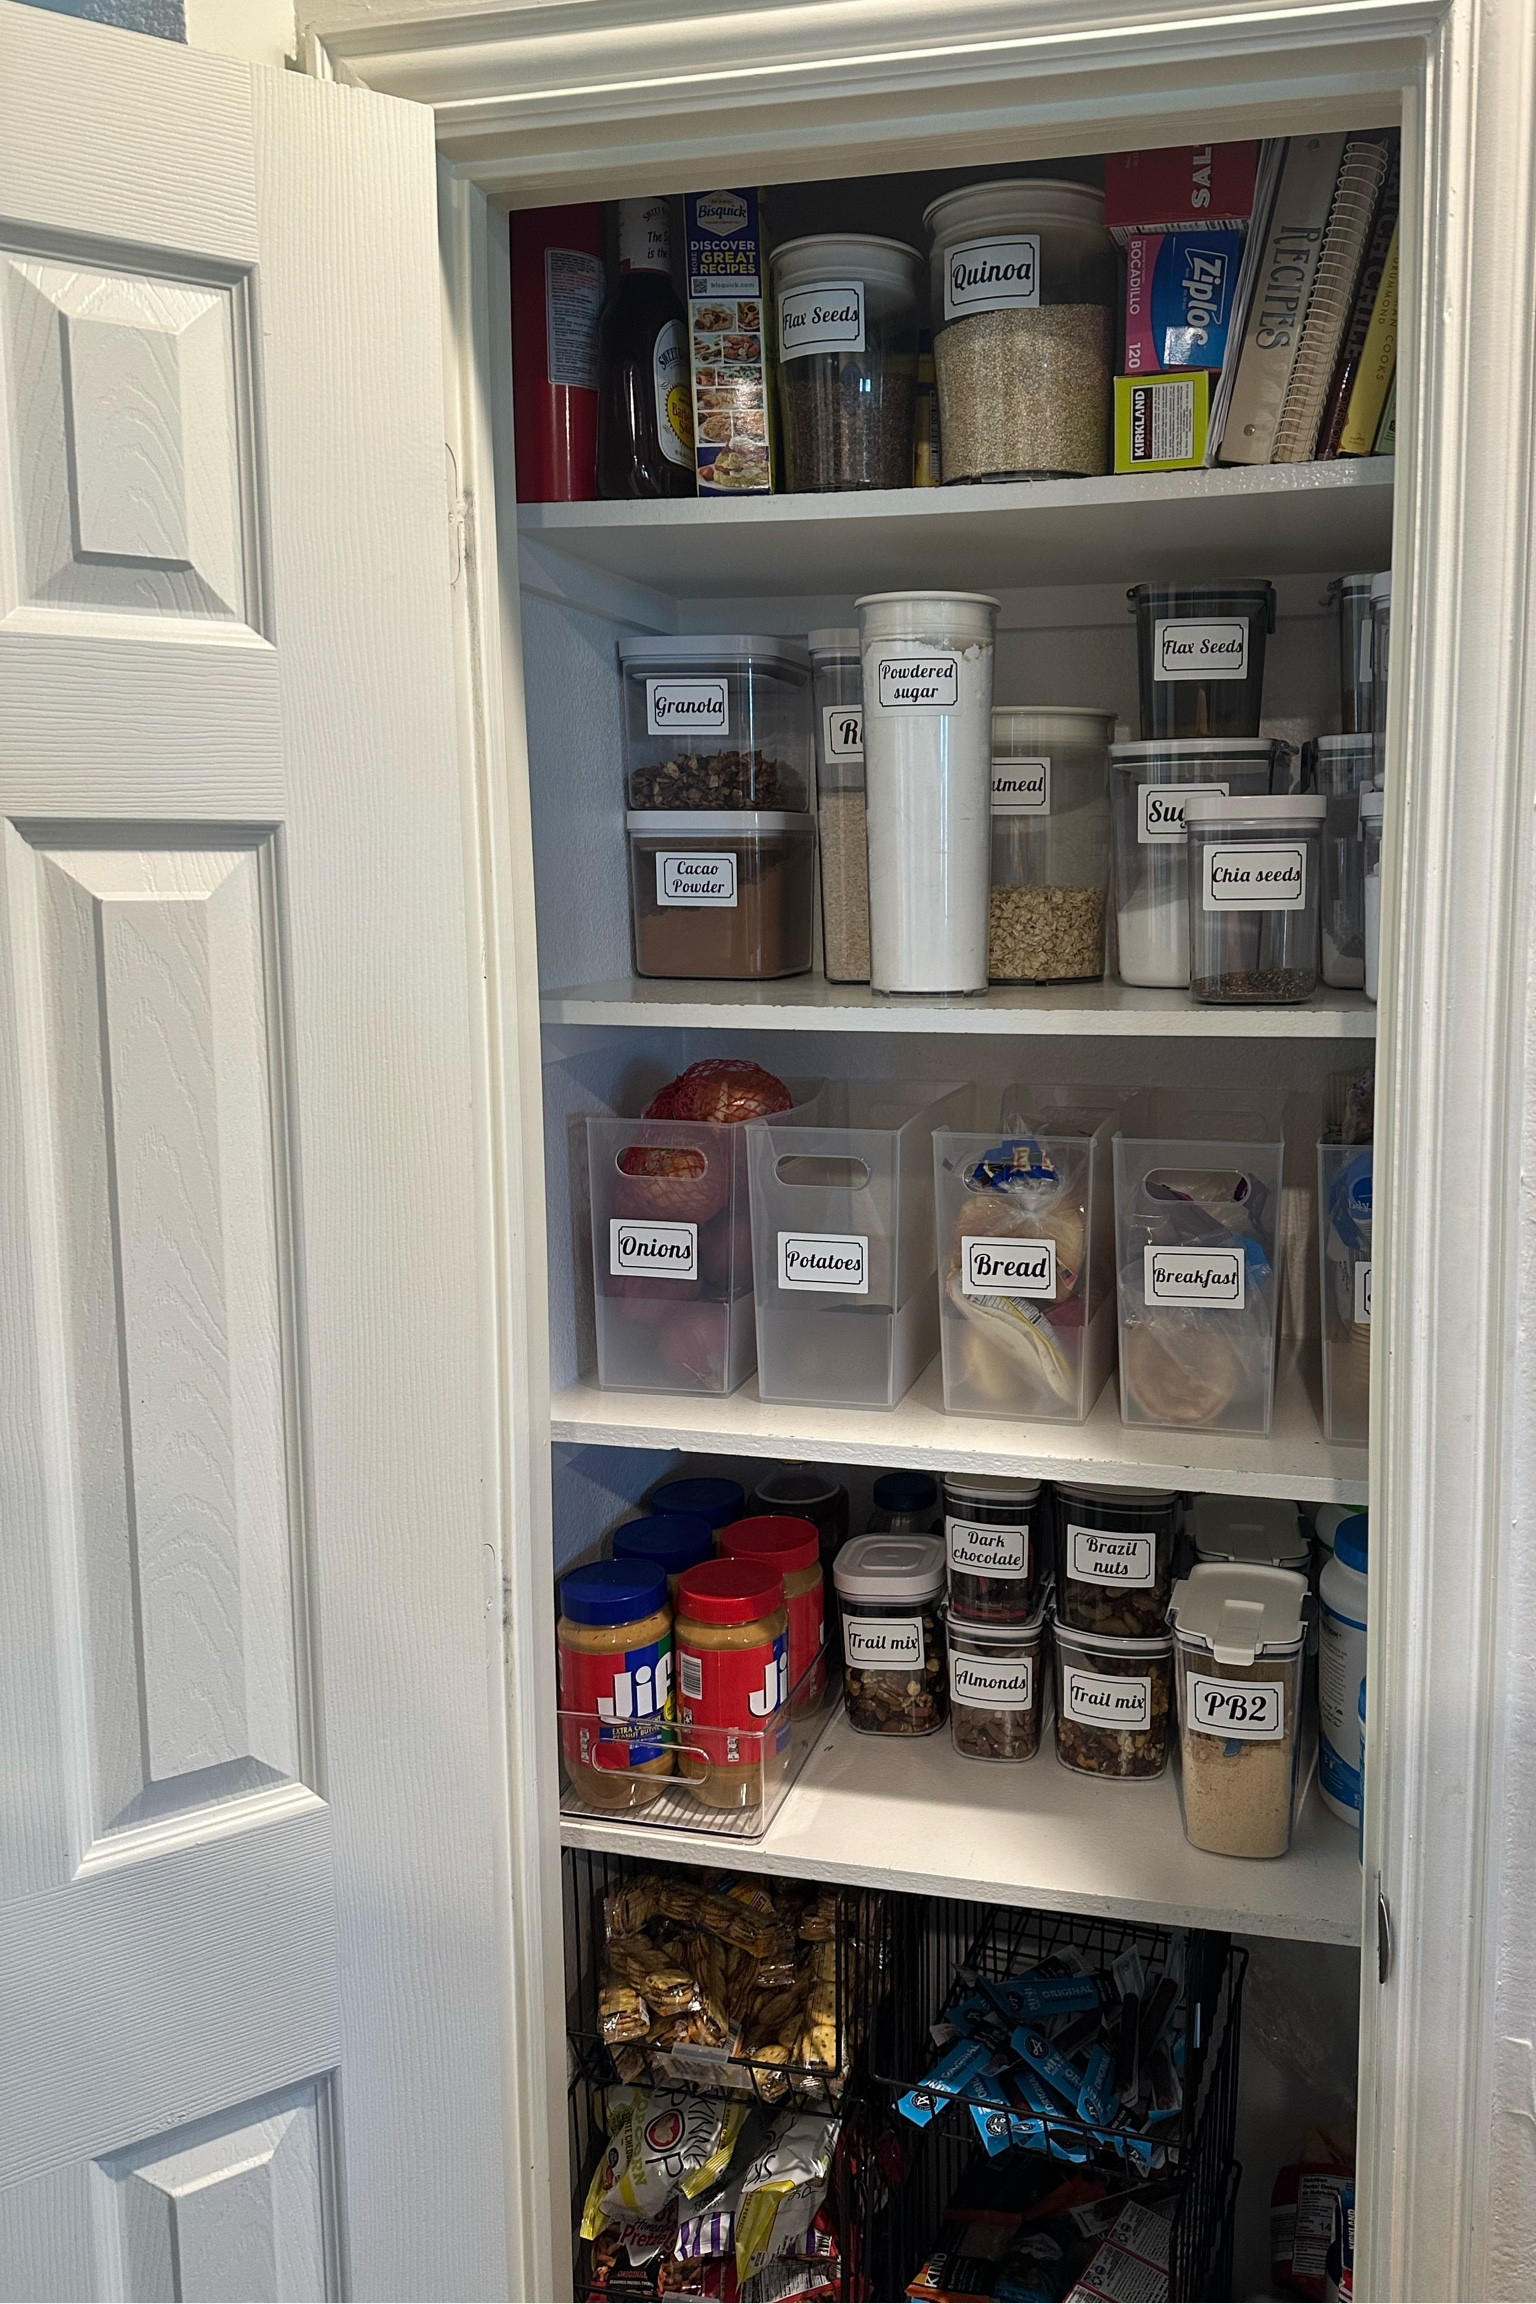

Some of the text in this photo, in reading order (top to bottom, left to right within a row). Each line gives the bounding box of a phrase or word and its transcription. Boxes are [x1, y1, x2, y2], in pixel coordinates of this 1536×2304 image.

[698, 204, 747, 219] Bisquick
[648, 231, 662, 243] The
[690, 240, 756, 250] DISCOVER
[701, 252, 757, 263] GREAT
[700, 264, 756, 274] RECIPES
[953, 260, 1032, 290] Quinoa
[1129, 240, 1142, 315] BOCADILLO
[710, 282, 755, 290] bisquick.com
[1256, 225, 1322, 350] RECIPES
[1182, 257, 1222, 346] Ziploc
[783, 304, 859, 331] Flax Seeds
[1128, 342, 1141, 369] 120
[1375, 334, 1394, 381] COOKS
[1134, 390, 1146, 457] KIRKLAND
[1163, 638, 1243, 655] Flax Seeds
[881, 662, 953, 680] Powdered
[893, 684, 939, 702] sugar
[654, 697, 724, 717] Granola
[676, 860, 719, 877] Cacao
[1212, 865, 1301, 883] Chia seeds
[672, 878, 725, 894] Powder
[619, 1235, 692, 1260] Onions
[787, 1250, 863, 1272] Potatoes
[974, 1253, 1048, 1278] Bread
[1153, 1267, 1237, 1288] Breakfast
[968, 1531, 1005, 1548] Dark
[1086, 1537, 1138, 1556] Brazil
[953, 1548, 1021, 1566] chocolate
[1093, 1560, 1129, 1576] nuts
[850, 1633, 919, 1649] Trail mix
[596, 1651, 674, 1725] Jif
[956, 1670, 1026, 1691] Almonds
[1071, 1686, 1146, 1709] Trail mix
[1204, 1691, 1267, 1722] PB2
[612, 1726, 633, 1734] EXTRA
[1041, 1984, 1095, 1998] ORIGINAL
[924, 2251, 948, 2288] KIND
